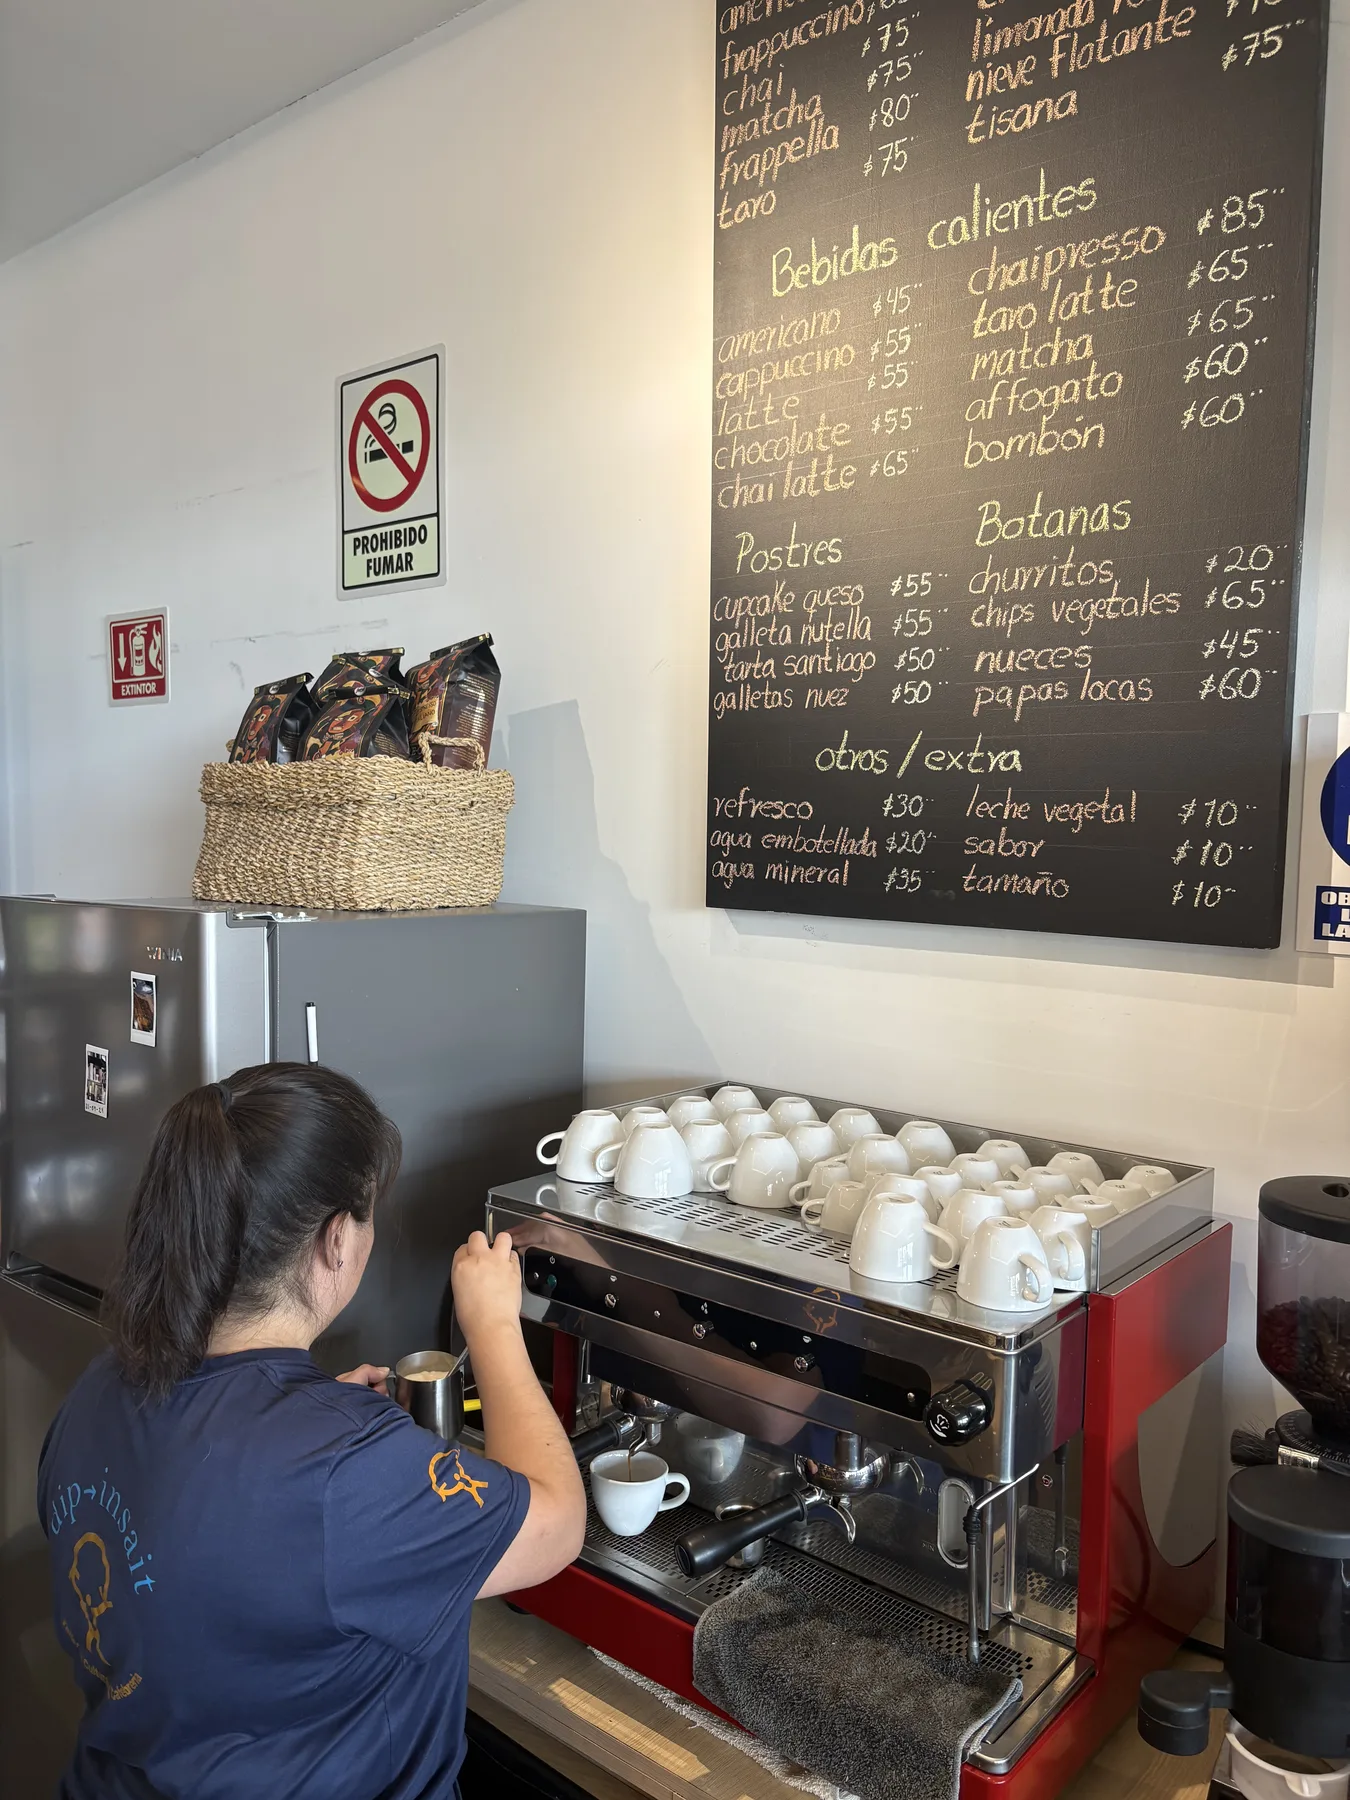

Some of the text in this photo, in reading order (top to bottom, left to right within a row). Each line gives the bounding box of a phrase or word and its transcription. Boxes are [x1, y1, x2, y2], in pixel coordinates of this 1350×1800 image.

[721, 0, 865, 79] frappuccino
[723, 63, 784, 116] chai
[965, 55, 1036, 101] nieve
[721, 88, 822, 152] matcha
[965, 90, 1078, 145] tisana
[720, 113, 840, 190] frappella
[717, 190, 777, 230] taro
[772, 168, 1098, 297] Bebidas calientes
[968, 225, 1167, 295] chaipresso
[972, 300, 1038, 339] taro
[1049, 271, 1138, 325] latte
[718, 308, 841, 363] americano
[971, 327, 1093, 381] matcha
[716, 344, 855, 401] cappuccino
[965, 360, 1124, 422] affogato
[718, 393, 799, 436] latte
[714, 413, 851, 470] chocolate
[717, 472, 776, 509] chai
[782, 454, 857, 499] latte
[353, 524, 428, 556] PROHIBIDO
[975, 491, 1132, 547] Botanas
[366, 552, 414, 578] FUMAR
[735, 521, 843, 573] Postres
[969, 545, 1114, 595] churritos
[713, 579, 796, 629] cupcake
[803, 584, 864, 622] queso
[971, 596, 1035, 638] chips
[1052, 577, 1181, 635] vegetales
[715, 615, 792, 662] galleta
[800, 605, 872, 646] nutella
[724, 650, 776, 683] tarta
[783, 641, 876, 683] santiago
[974, 645, 1093, 674] nueces
[121, 682, 157, 696] EXTINTOR
[713, 680, 794, 720] galletas
[805, 687, 850, 709] nuez
[972, 680, 1068, 722] papas
[1080, 669, 1153, 702] locas
[815, 730, 889, 775] otros
[924, 733, 1022, 774] extra
[714, 786, 813, 820] refresco
[966, 784, 1031, 821] leche
[1044, 787, 1136, 833] vegetal
[710, 830, 751, 857] agua
[761, 825, 877, 858] embotellada
[964, 827, 1045, 857] sabor
[712, 861, 754, 889] agua
[765, 859, 849, 886] mineral
[962, 864, 1070, 899] tamaño
[146, 946, 183, 962] WINIA
